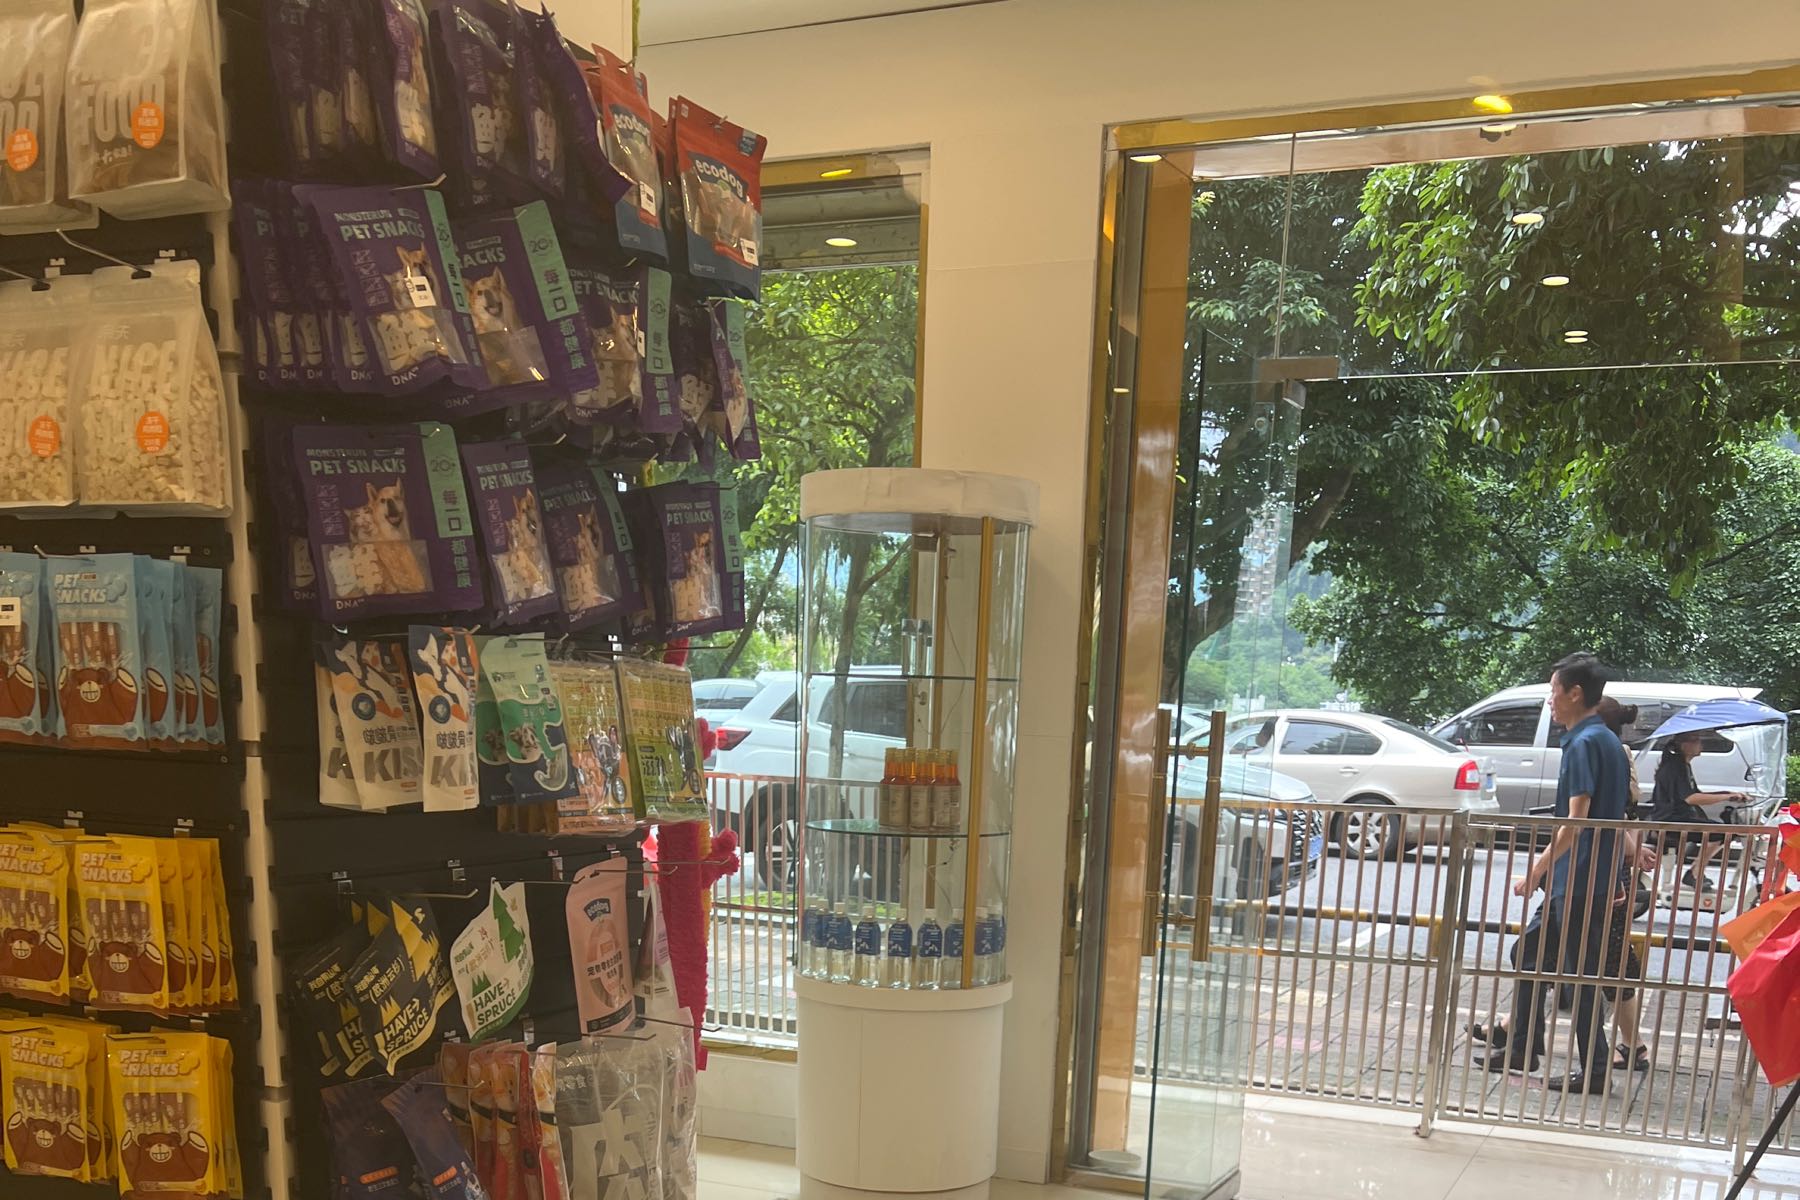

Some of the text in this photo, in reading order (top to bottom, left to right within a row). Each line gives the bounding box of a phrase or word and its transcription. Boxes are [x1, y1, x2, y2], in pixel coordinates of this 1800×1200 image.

[695, 159, 744, 197] ecodog
[340, 221, 425, 243] PET SNACKS
[455, 247, 506, 269] ACKS
[573, 280, 593, 296] ET
[310, 458, 406, 476] PET SNACKS
[666, 512, 684, 526] PET
[55, 573, 80, 588] PET
[56, 588, 107, 604] SNACKS
[364, 748, 424, 785] KIS
[0, 844, 18, 858] ET
[0, 857, 44, 875] NACKS
[80, 853, 108, 868] PET
[82, 868, 133, 884] SNACKS
[473, 982, 504, 1013] HAVE
[384, 1002, 415, 1041] HAVE
[386, 1007, 430, 1053] SPRUCE
[11, 1036, 38, 1050] PET
[12, 1049, 65, 1068] SNACKS
[119, 1049, 149, 1064] PET
[120, 1062, 180, 1077] SNACKS
